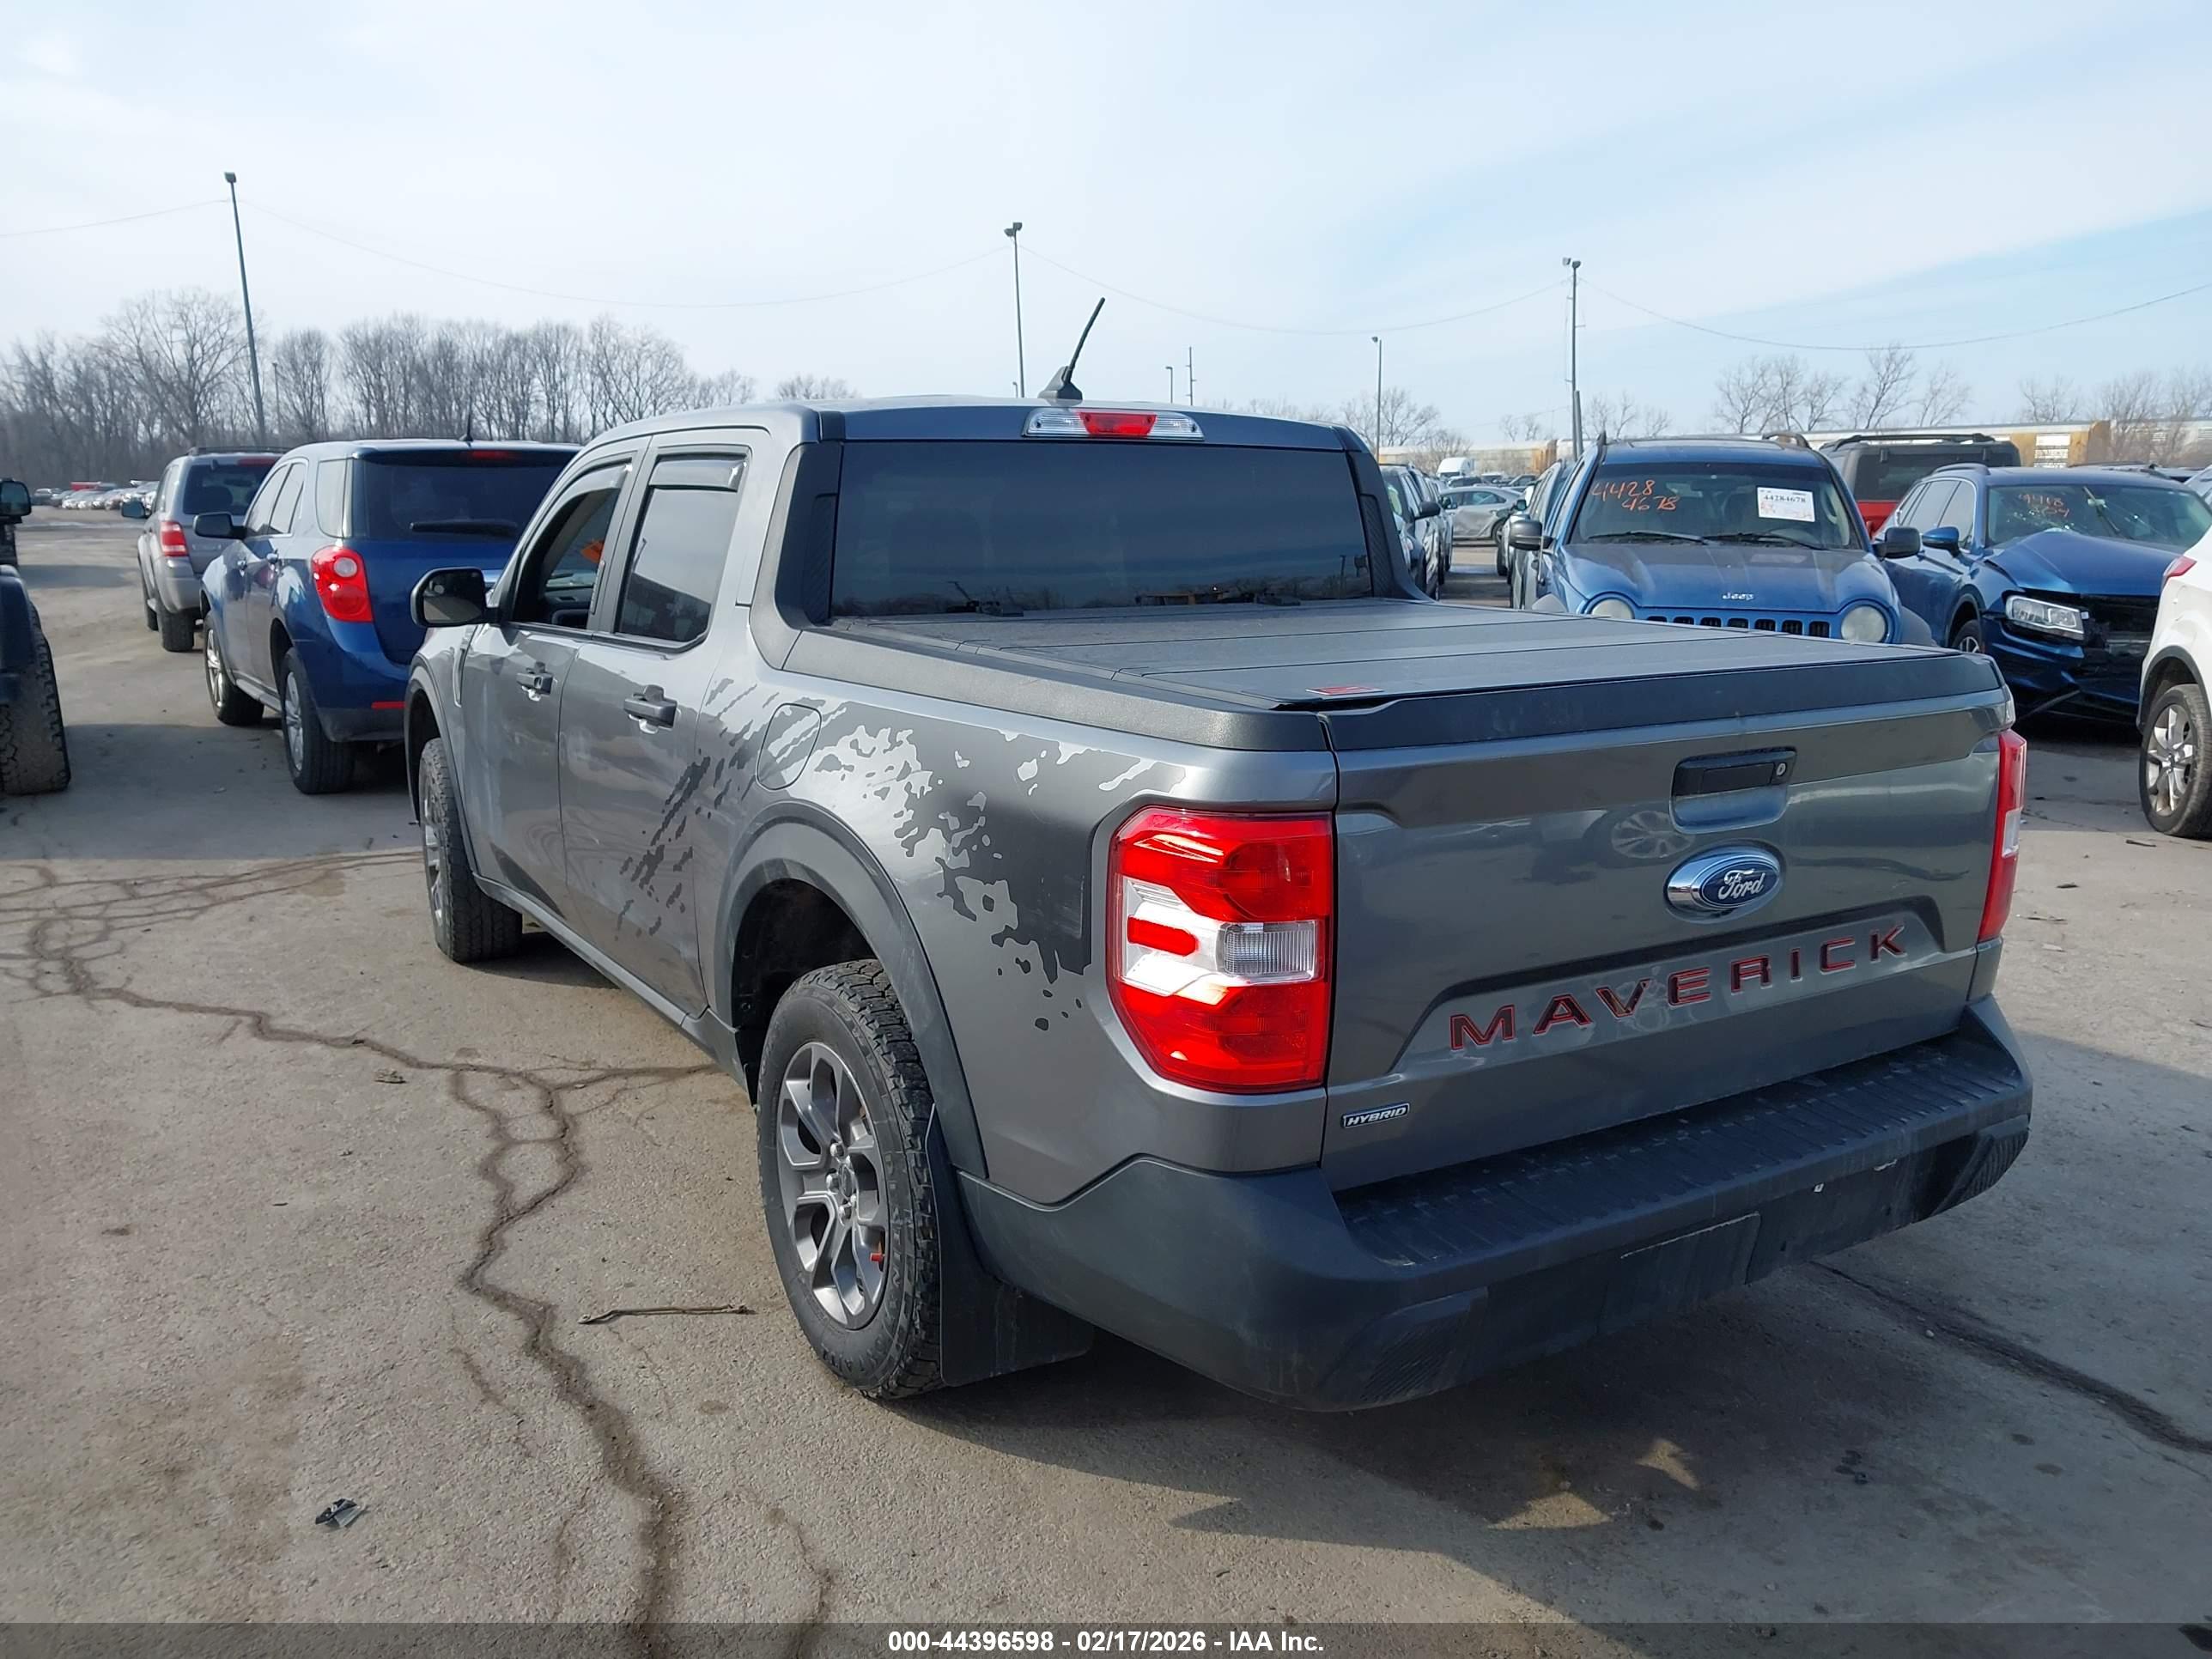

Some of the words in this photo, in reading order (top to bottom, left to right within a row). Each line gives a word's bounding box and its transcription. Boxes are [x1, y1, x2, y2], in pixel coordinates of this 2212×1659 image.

[1592, 480, 1656, 501] 4428
[1621, 495, 1680, 510] 4678
[1722, 592, 1753, 601] Jeep
[1717, 868, 1766, 900] Ford
[1449, 924, 1907, 1051] MAVERICK
[1346, 1107, 1407, 1127] HYBRID
